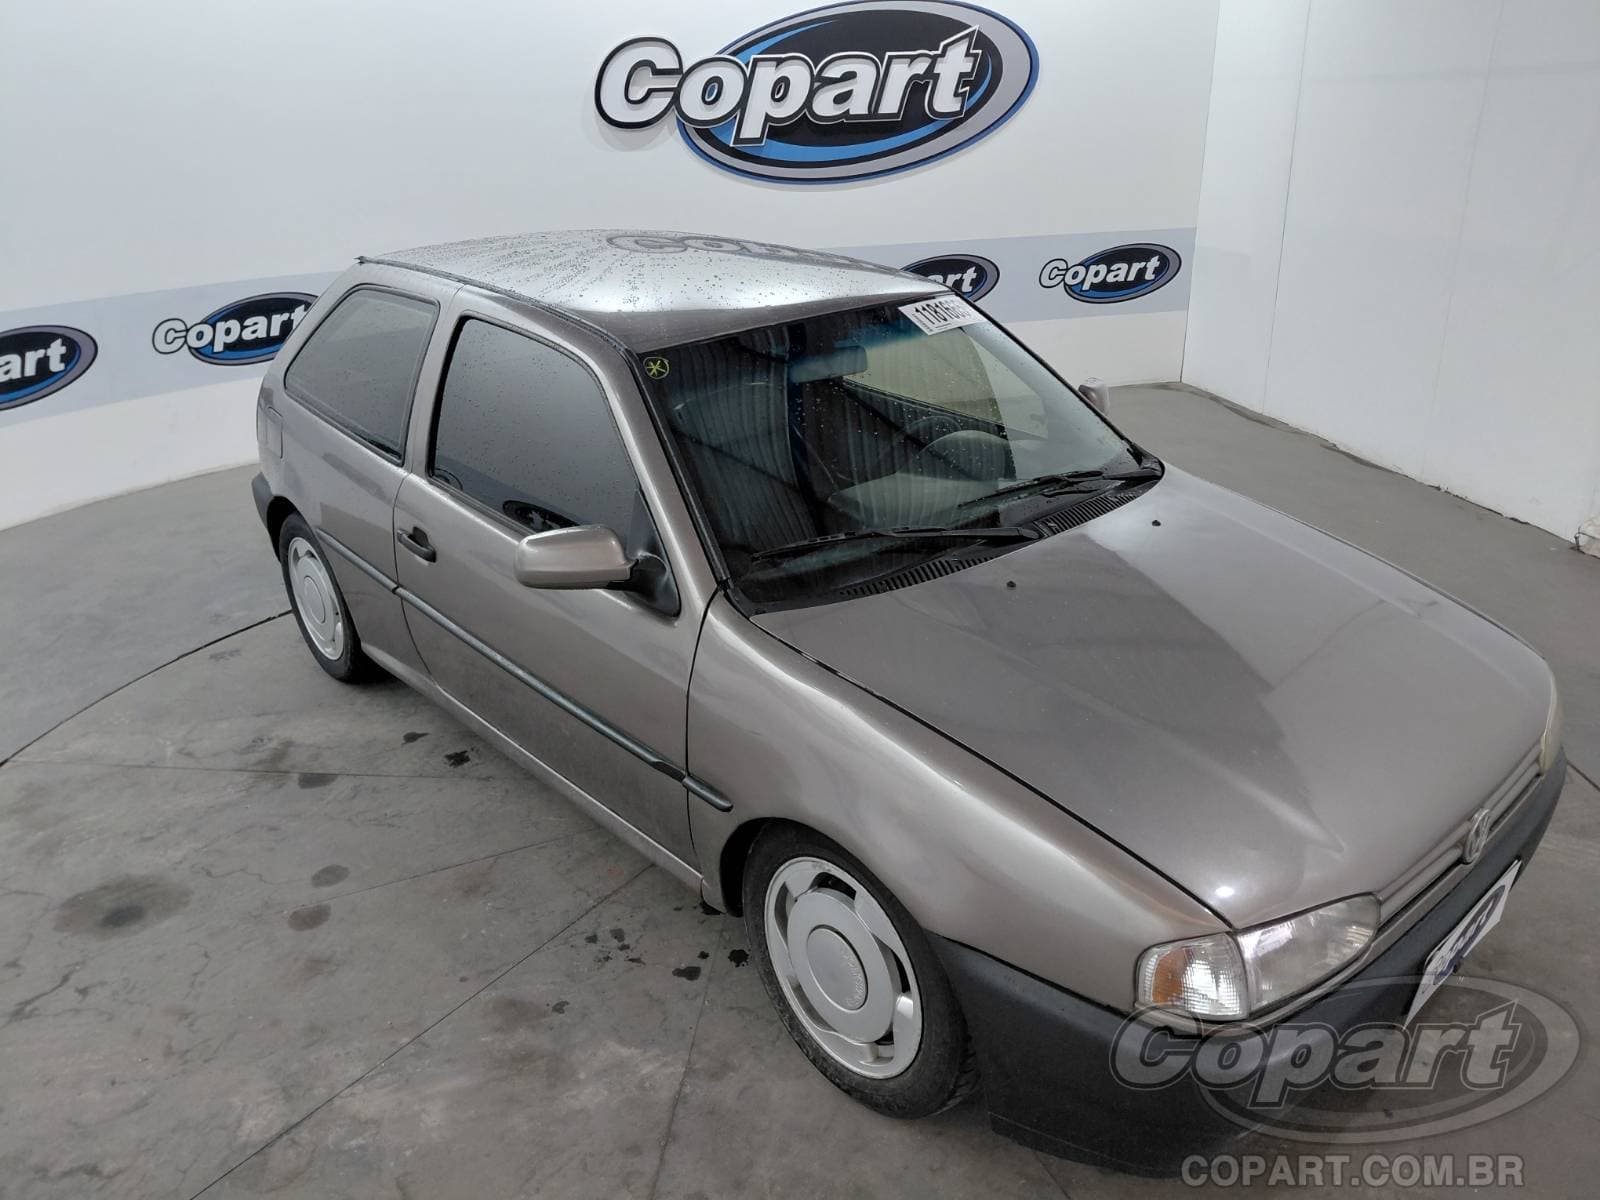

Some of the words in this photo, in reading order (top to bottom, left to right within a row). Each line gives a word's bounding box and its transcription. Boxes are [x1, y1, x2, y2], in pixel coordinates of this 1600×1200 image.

[593, 25, 982, 146] Copart
[1039, 255, 1161, 292] Copart
[0, 337, 67, 383] art
